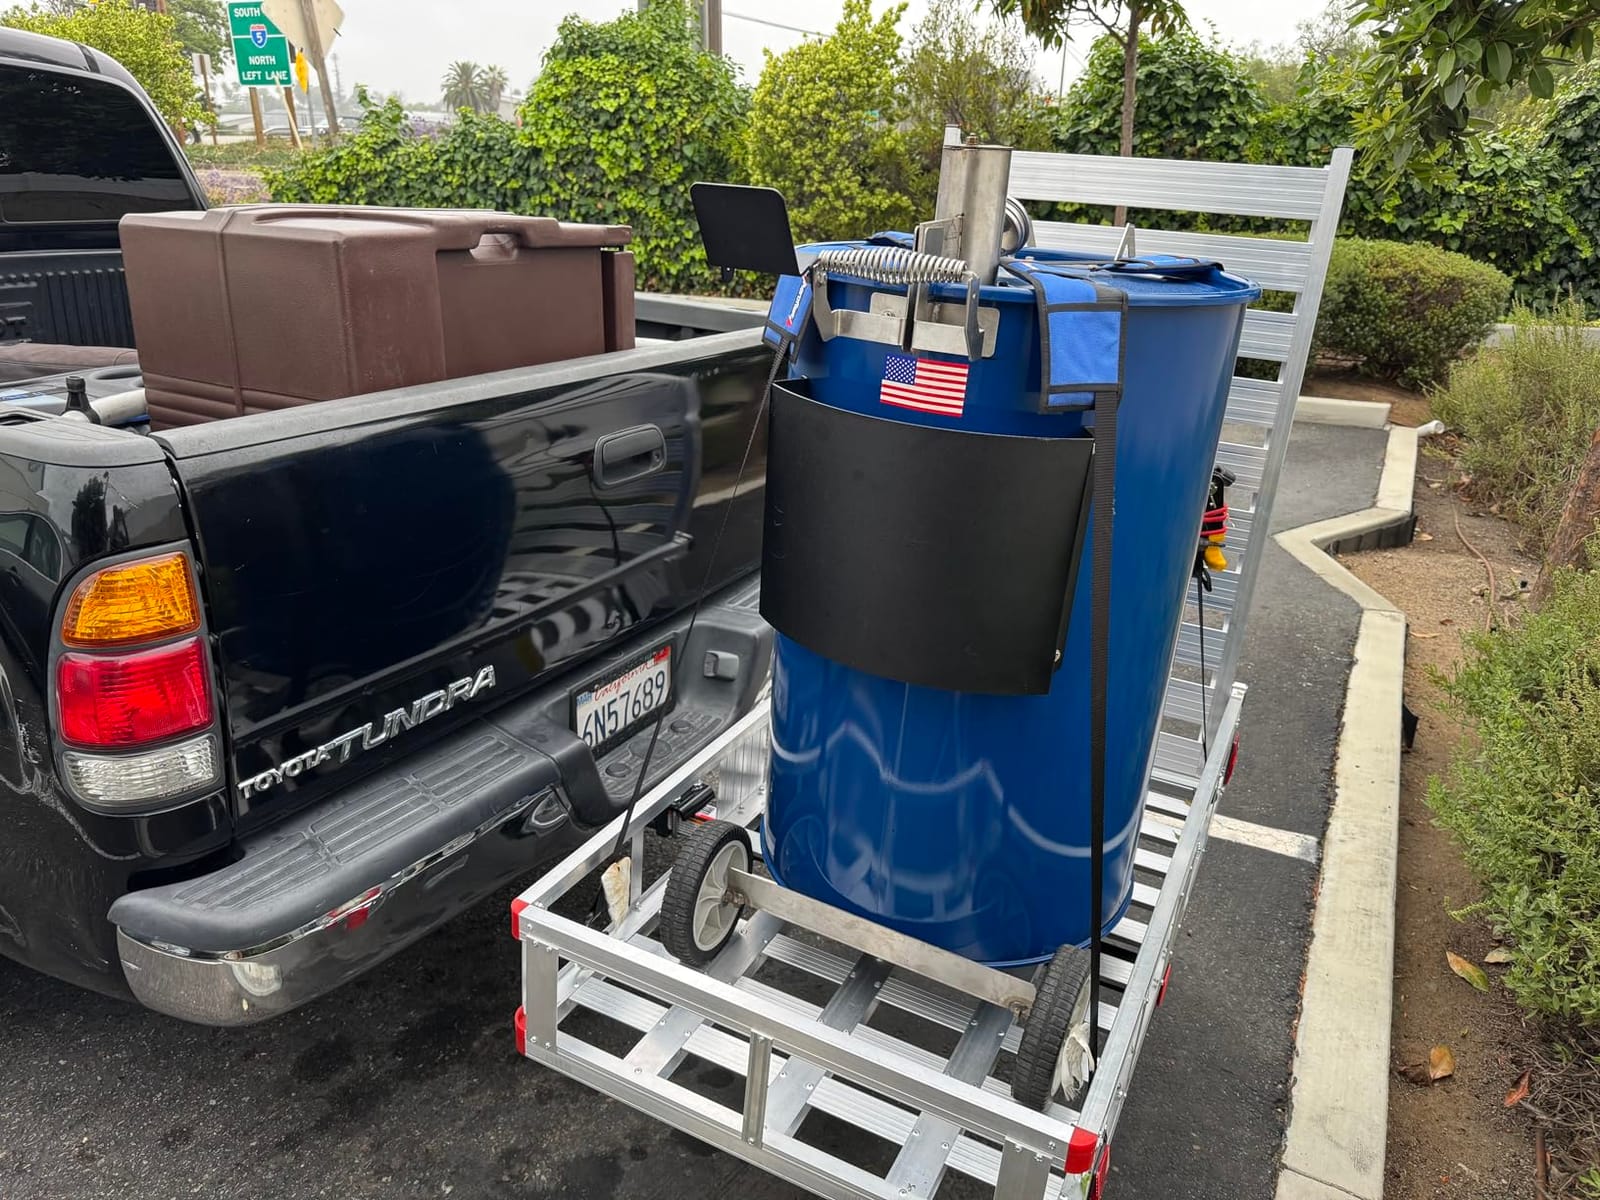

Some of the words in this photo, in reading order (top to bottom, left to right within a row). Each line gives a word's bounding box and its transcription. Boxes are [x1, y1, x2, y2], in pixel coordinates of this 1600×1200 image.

[234, 8, 260, 17] SOUTH
[256, 32, 264, 43] 5
[249, 56, 276, 65] NORTH
[242, 71, 262, 80] LEFT
[266, 71, 288, 80] LANE
[582, 670, 665, 748] 6N57689
[237, 749, 331, 800] TOYOTA
[322, 664, 496, 763] TUNDRA
